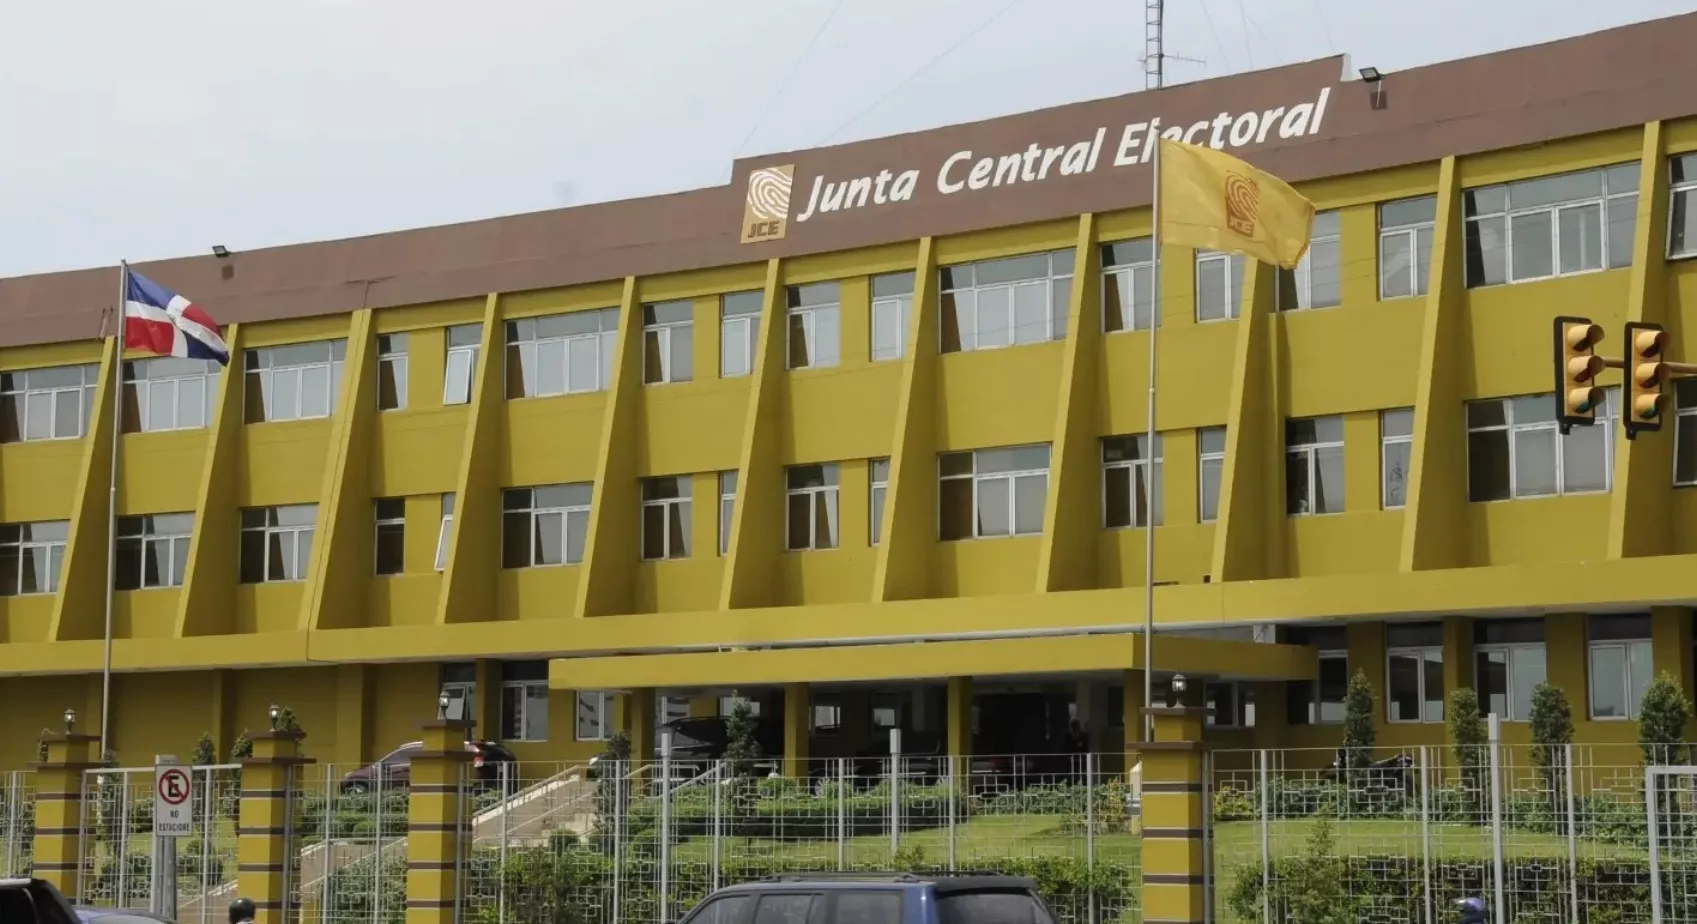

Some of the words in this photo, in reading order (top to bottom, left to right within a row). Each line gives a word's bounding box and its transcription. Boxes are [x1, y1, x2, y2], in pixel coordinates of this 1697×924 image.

[797, 169, 919, 222] Junta
[937, 127, 1107, 196] Central
[747, 220, 780, 238] JCE
[1229, 215, 1253, 234] JCE
[170, 810, 179, 818] NO
[159, 823, 189, 832] ESTACIONE
